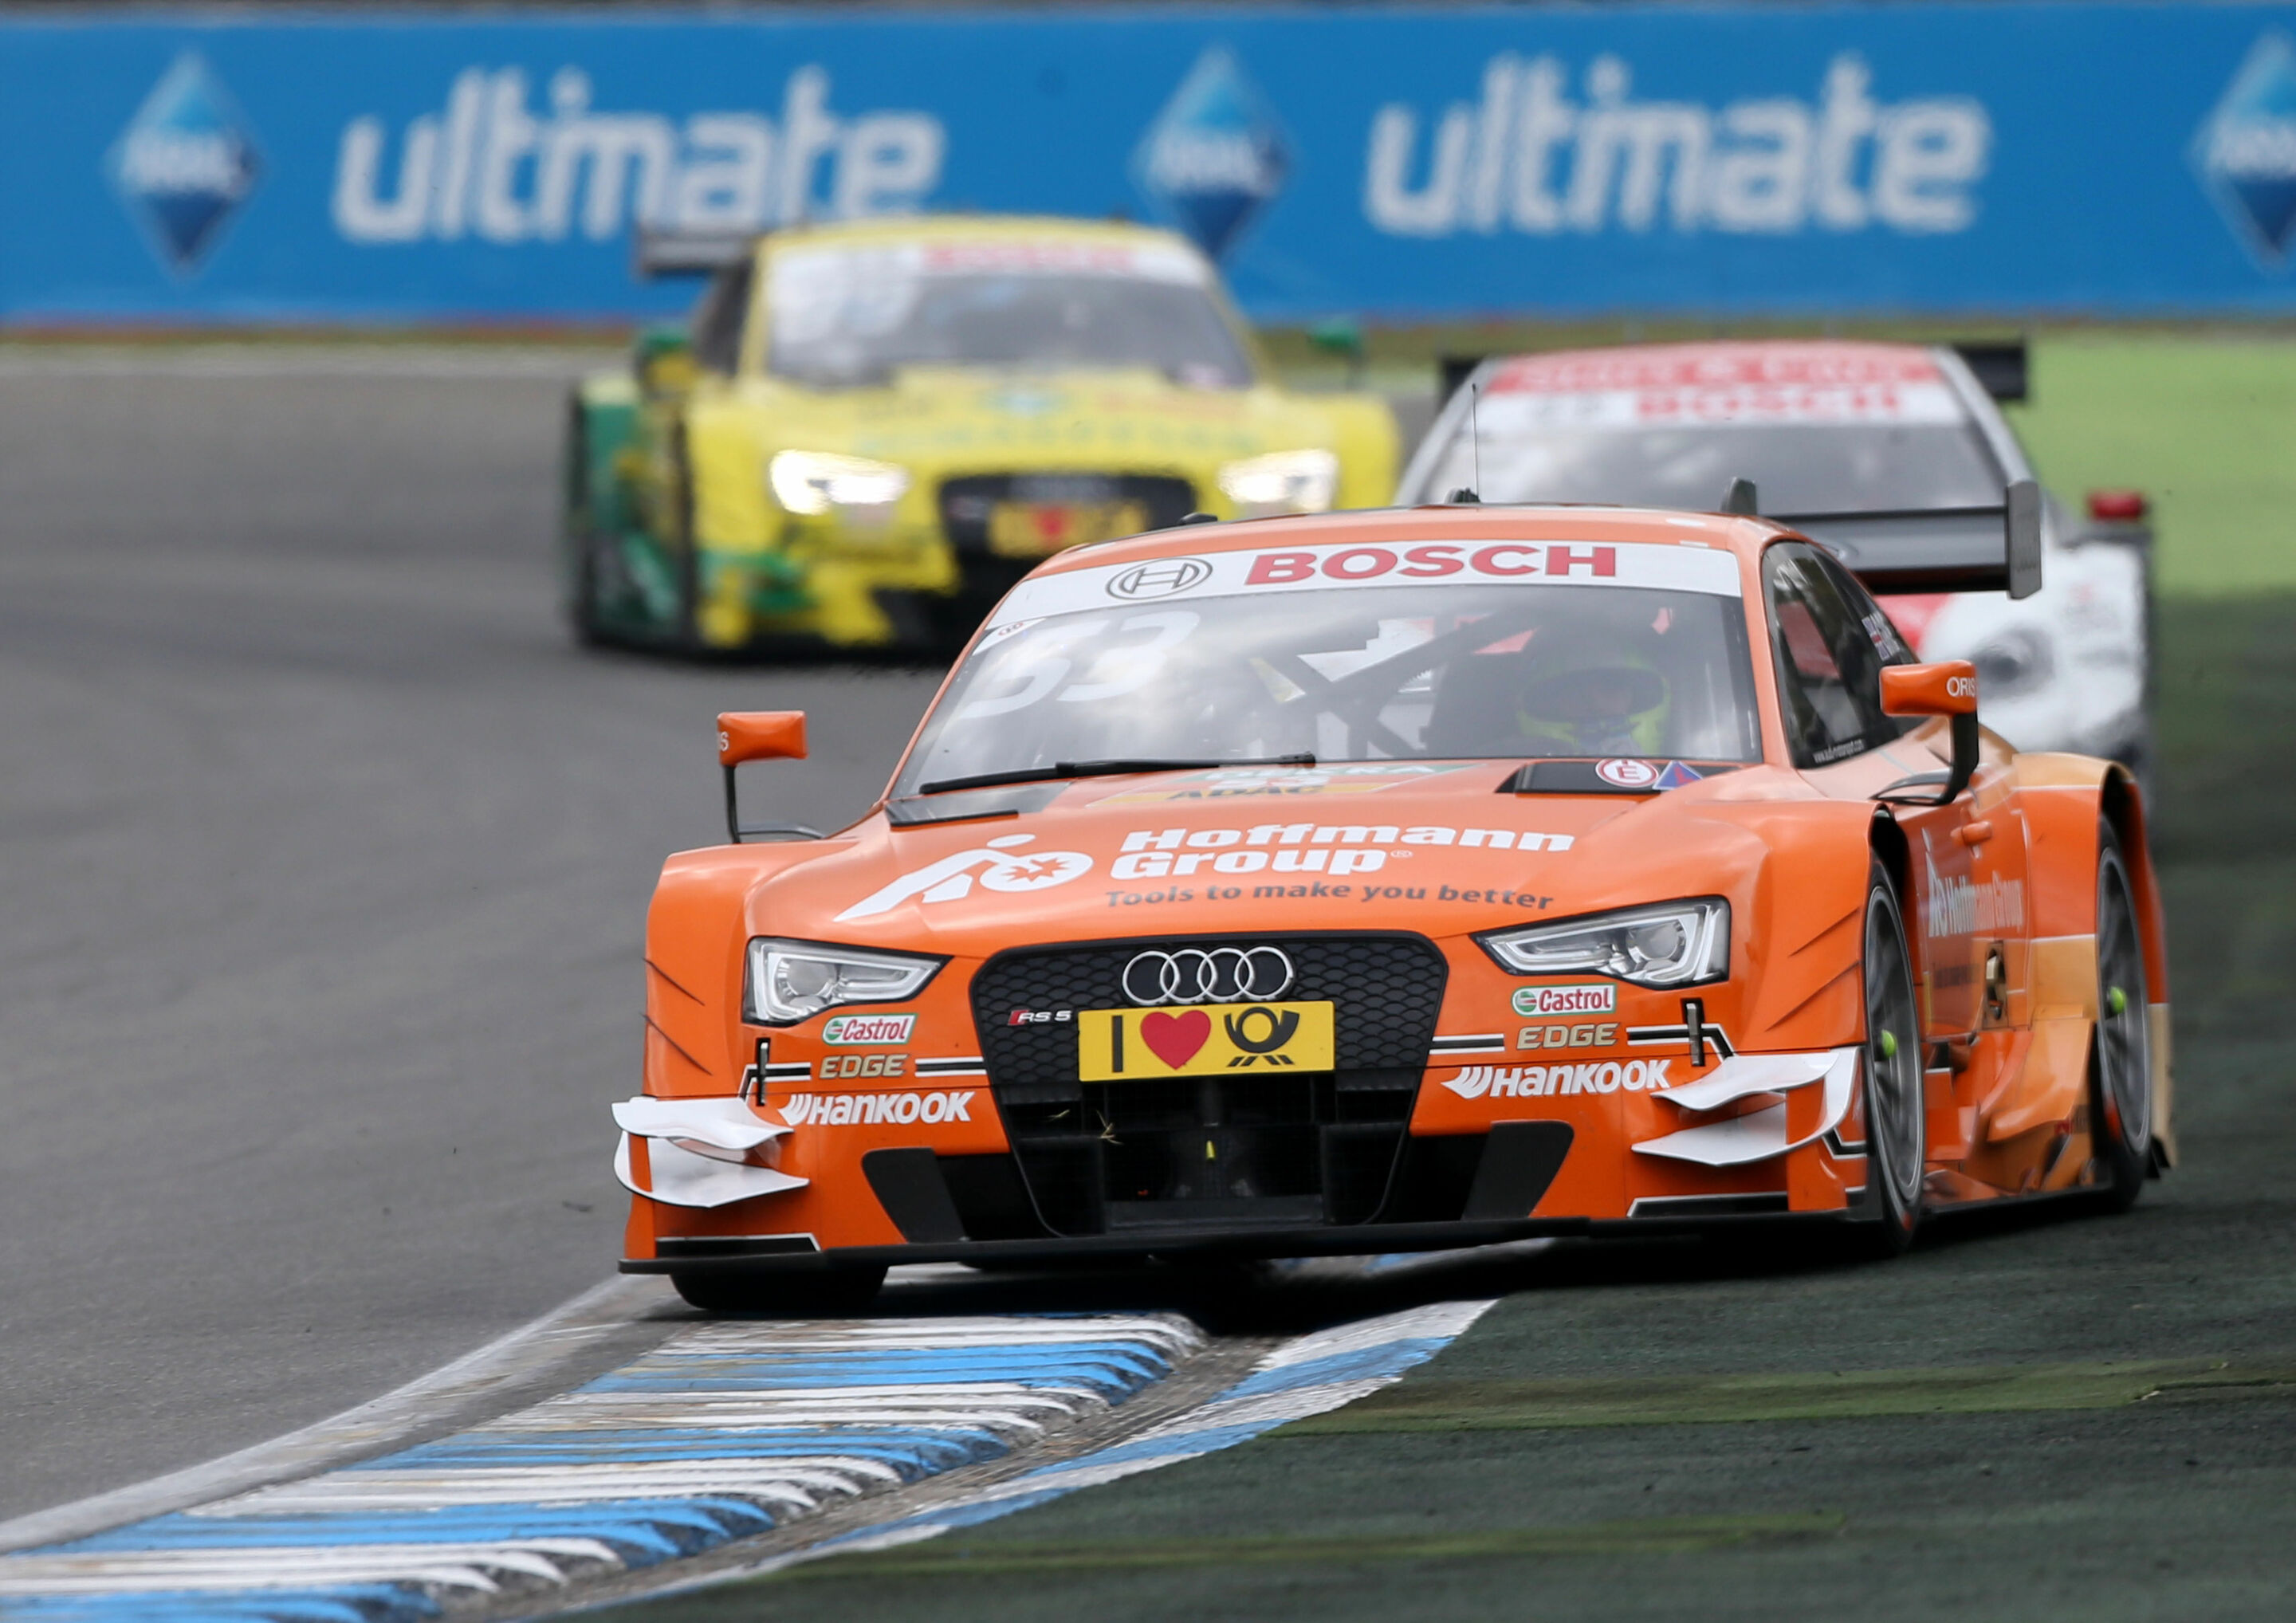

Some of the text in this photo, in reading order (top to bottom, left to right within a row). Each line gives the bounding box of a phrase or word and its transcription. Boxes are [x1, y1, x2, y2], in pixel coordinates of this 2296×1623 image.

[333, 65, 944, 242] ultimate
[1363, 53, 1990, 234] ultimate
[1244, 545, 1616, 585] BOSCH
[1120, 823, 1575, 852] Hoffmann
[1105, 880, 1554, 910] Tools to make you better
[1539, 988, 1610, 1012] Castrol
[843, 1017, 909, 1040] Castrol
[1017, 1009, 1072, 1023] RS 5
[1111, 1015, 1123, 1073] I
[1516, 1023, 1619, 1050] EDGE
[819, 1054, 909, 1079] EDGE
